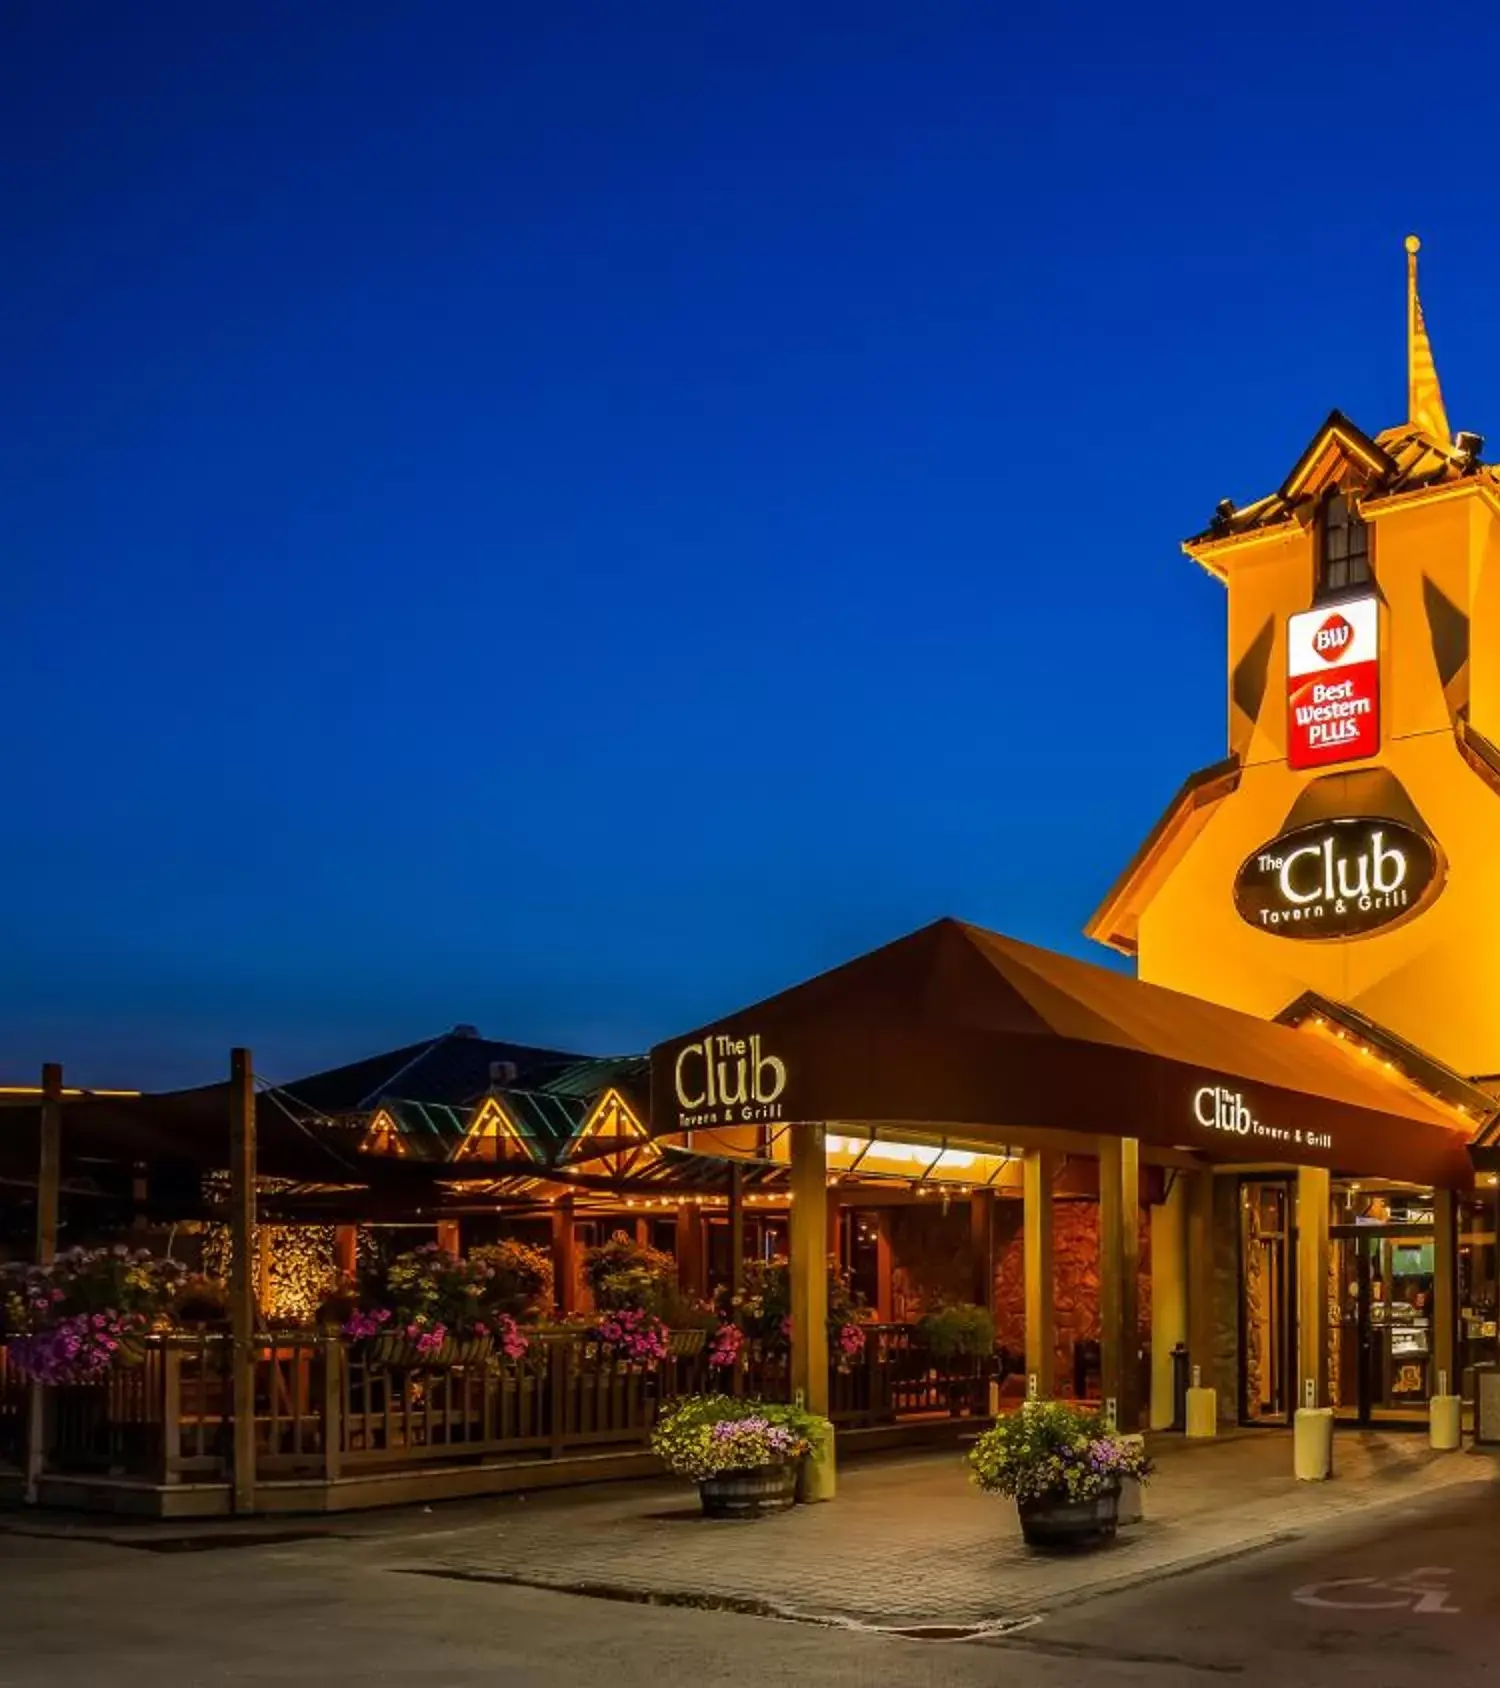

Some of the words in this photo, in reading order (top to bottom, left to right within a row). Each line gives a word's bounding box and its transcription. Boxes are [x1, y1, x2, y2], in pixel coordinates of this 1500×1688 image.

[1317, 626, 1349, 650] BW
[1313, 680, 1354, 703] Best
[1296, 698, 1371, 725] Western
[1258, 855, 1283, 872] The
[1280, 832, 1406, 903] Club
[1260, 906, 1324, 925] Tavern
[1335, 899, 1347, 914] &
[1358, 890, 1408, 911] Grill
[716, 1034, 746, 1056] The
[675, 1034, 787, 1109] Club
[725, 1109, 733, 1121] &
[741, 1104, 782, 1120] Grill
[1194, 1087, 1250, 1135] Club
[1252, 1121, 1290, 1140] Tavern
[1295, 1130, 1301, 1142] &
[1307, 1132, 1332, 1148] Grill
